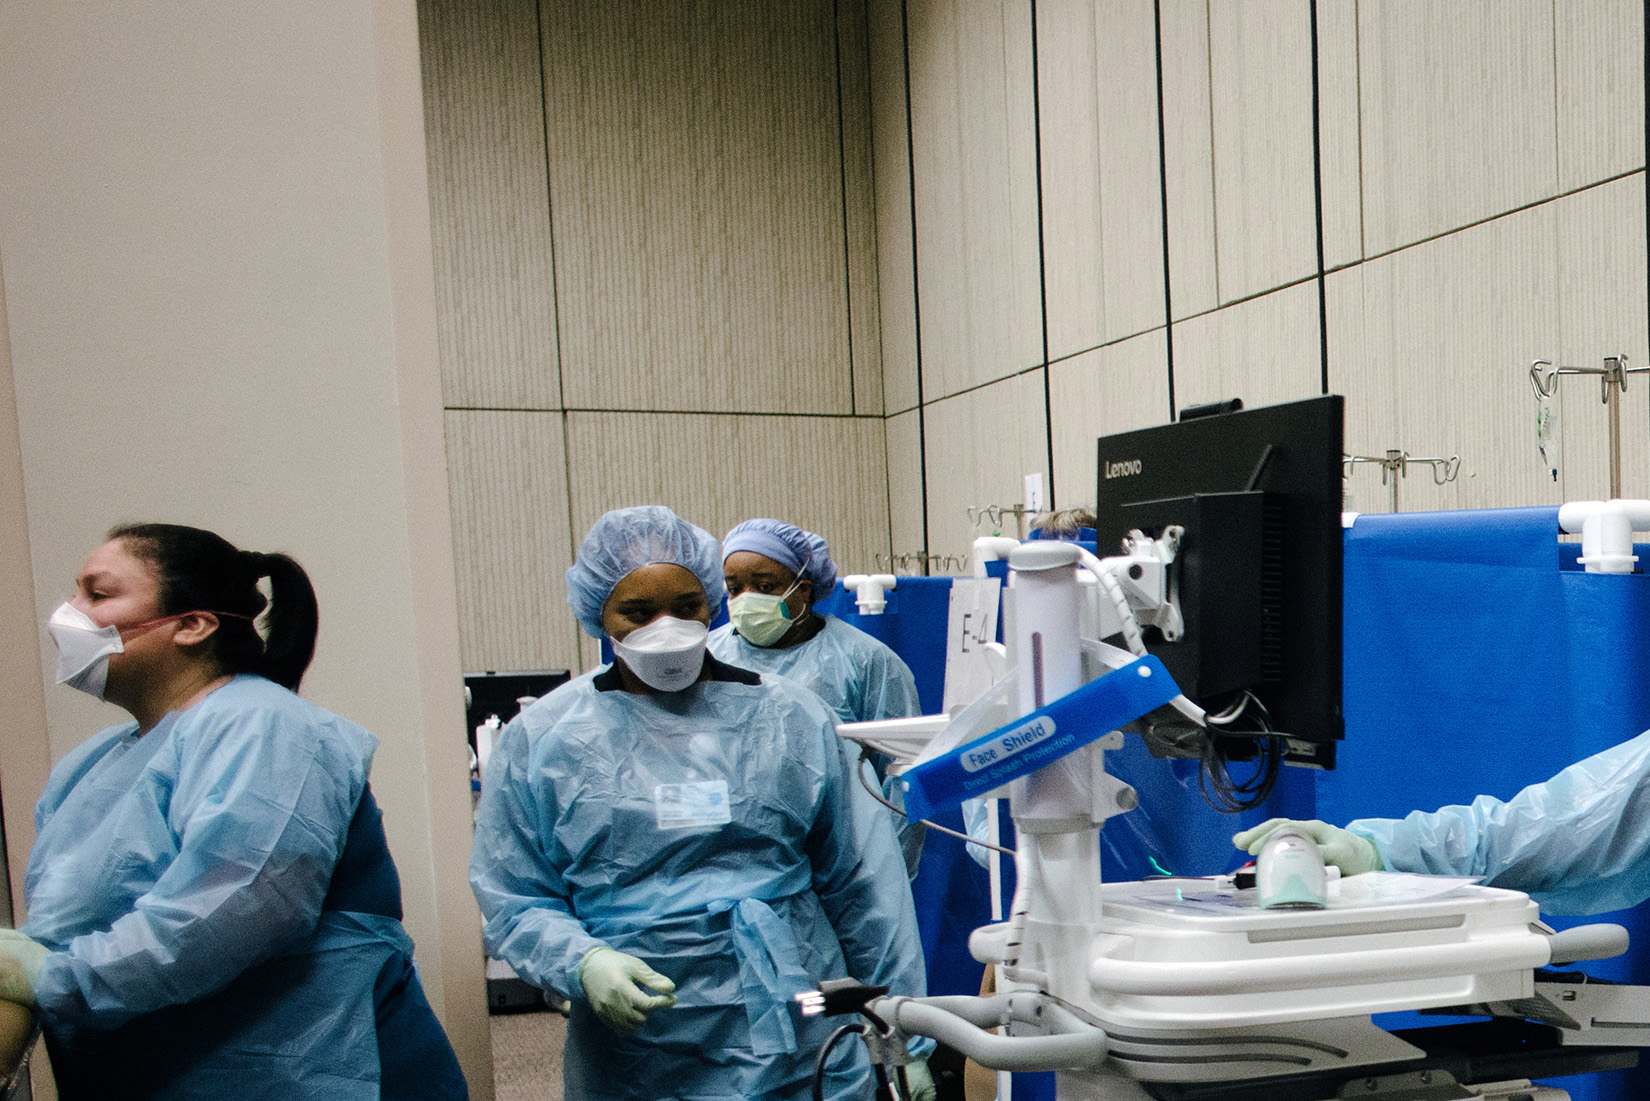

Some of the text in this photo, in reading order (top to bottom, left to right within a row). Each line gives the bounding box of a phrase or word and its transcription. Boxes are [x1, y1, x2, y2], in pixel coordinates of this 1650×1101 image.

[1105, 460, 1142, 479] Lenovo
[962, 613, 988, 653] E-4
[969, 723, 1046, 769] Face Shield
[990, 760, 1024, 779] Splash
[1024, 734, 1075, 764] Protection
